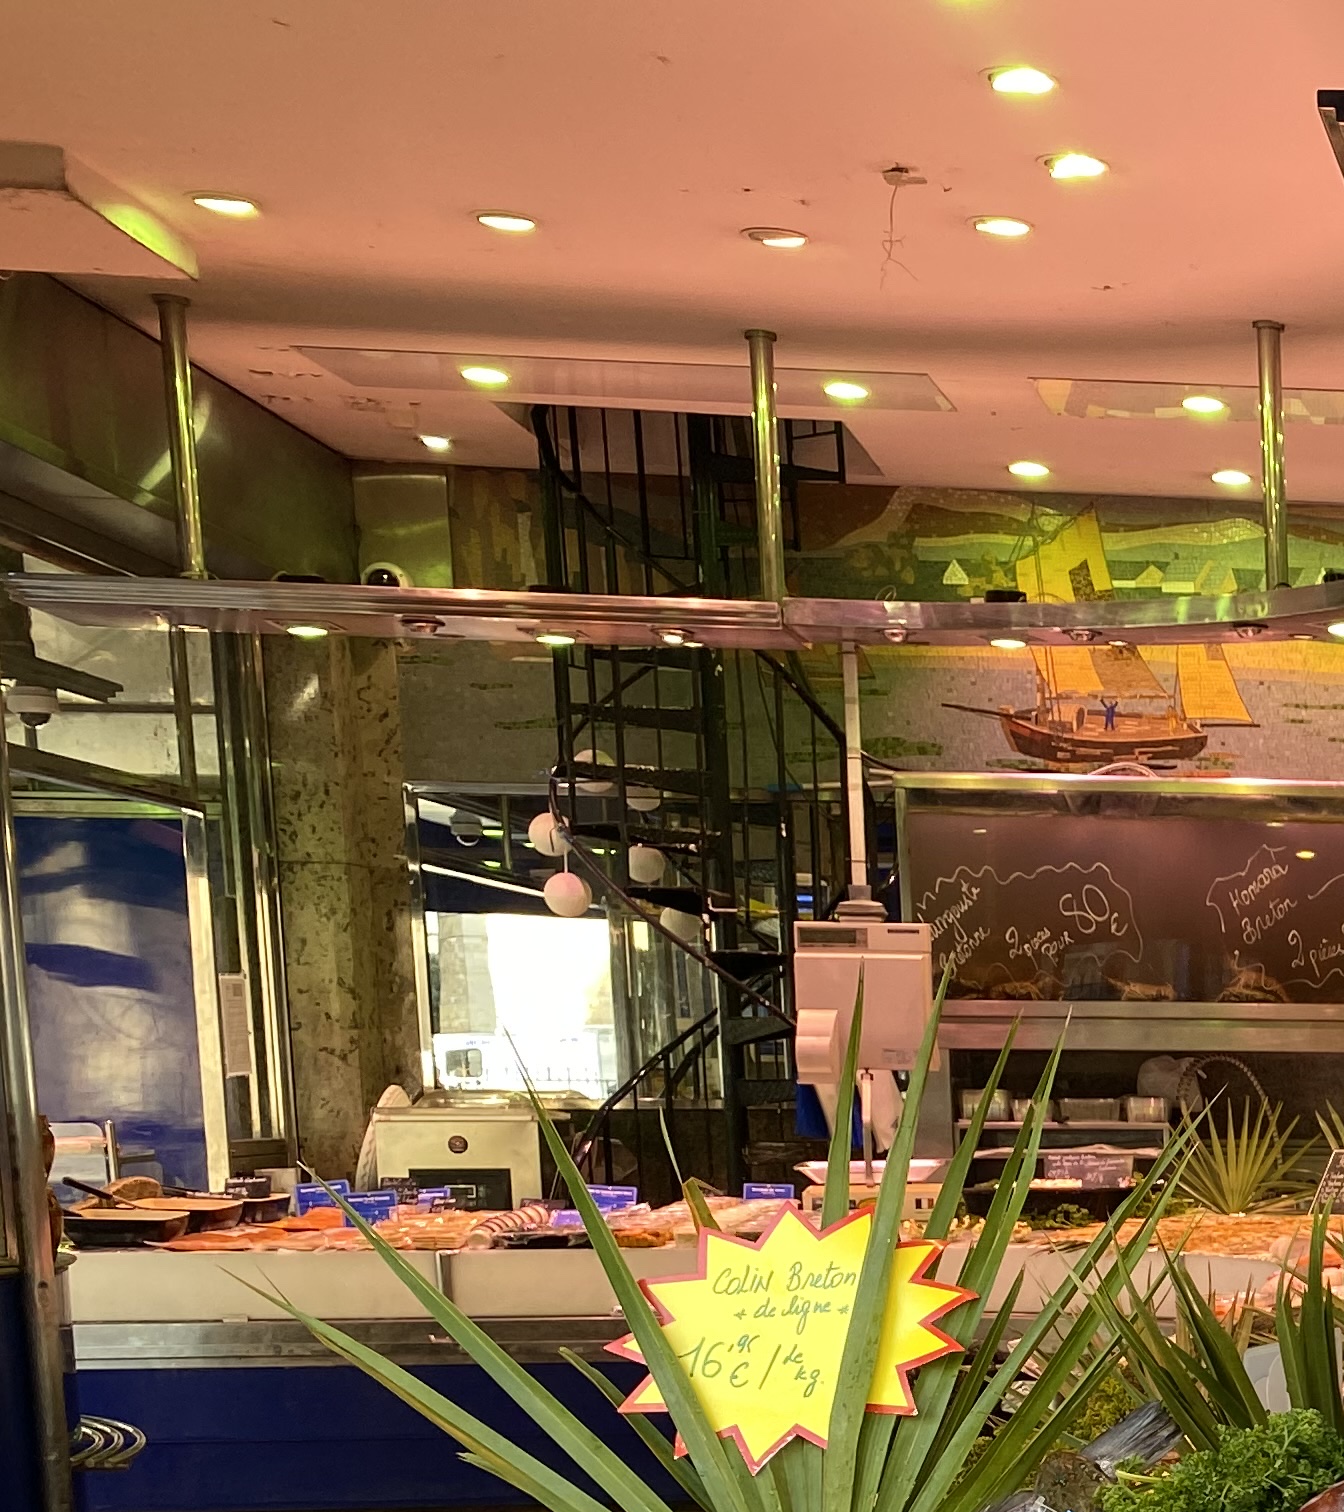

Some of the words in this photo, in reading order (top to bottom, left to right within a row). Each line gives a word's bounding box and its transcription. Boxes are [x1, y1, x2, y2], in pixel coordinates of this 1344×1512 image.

[1241, 898, 1298, 945] Breton
[1005, 926, 1022, 958] 2
[1288, 929, 1305, 968] 2
[786, 1261, 857, 1291] Breton
[753, 1297, 775, 1318] de
[781, 1295, 831, 1335] ligne
